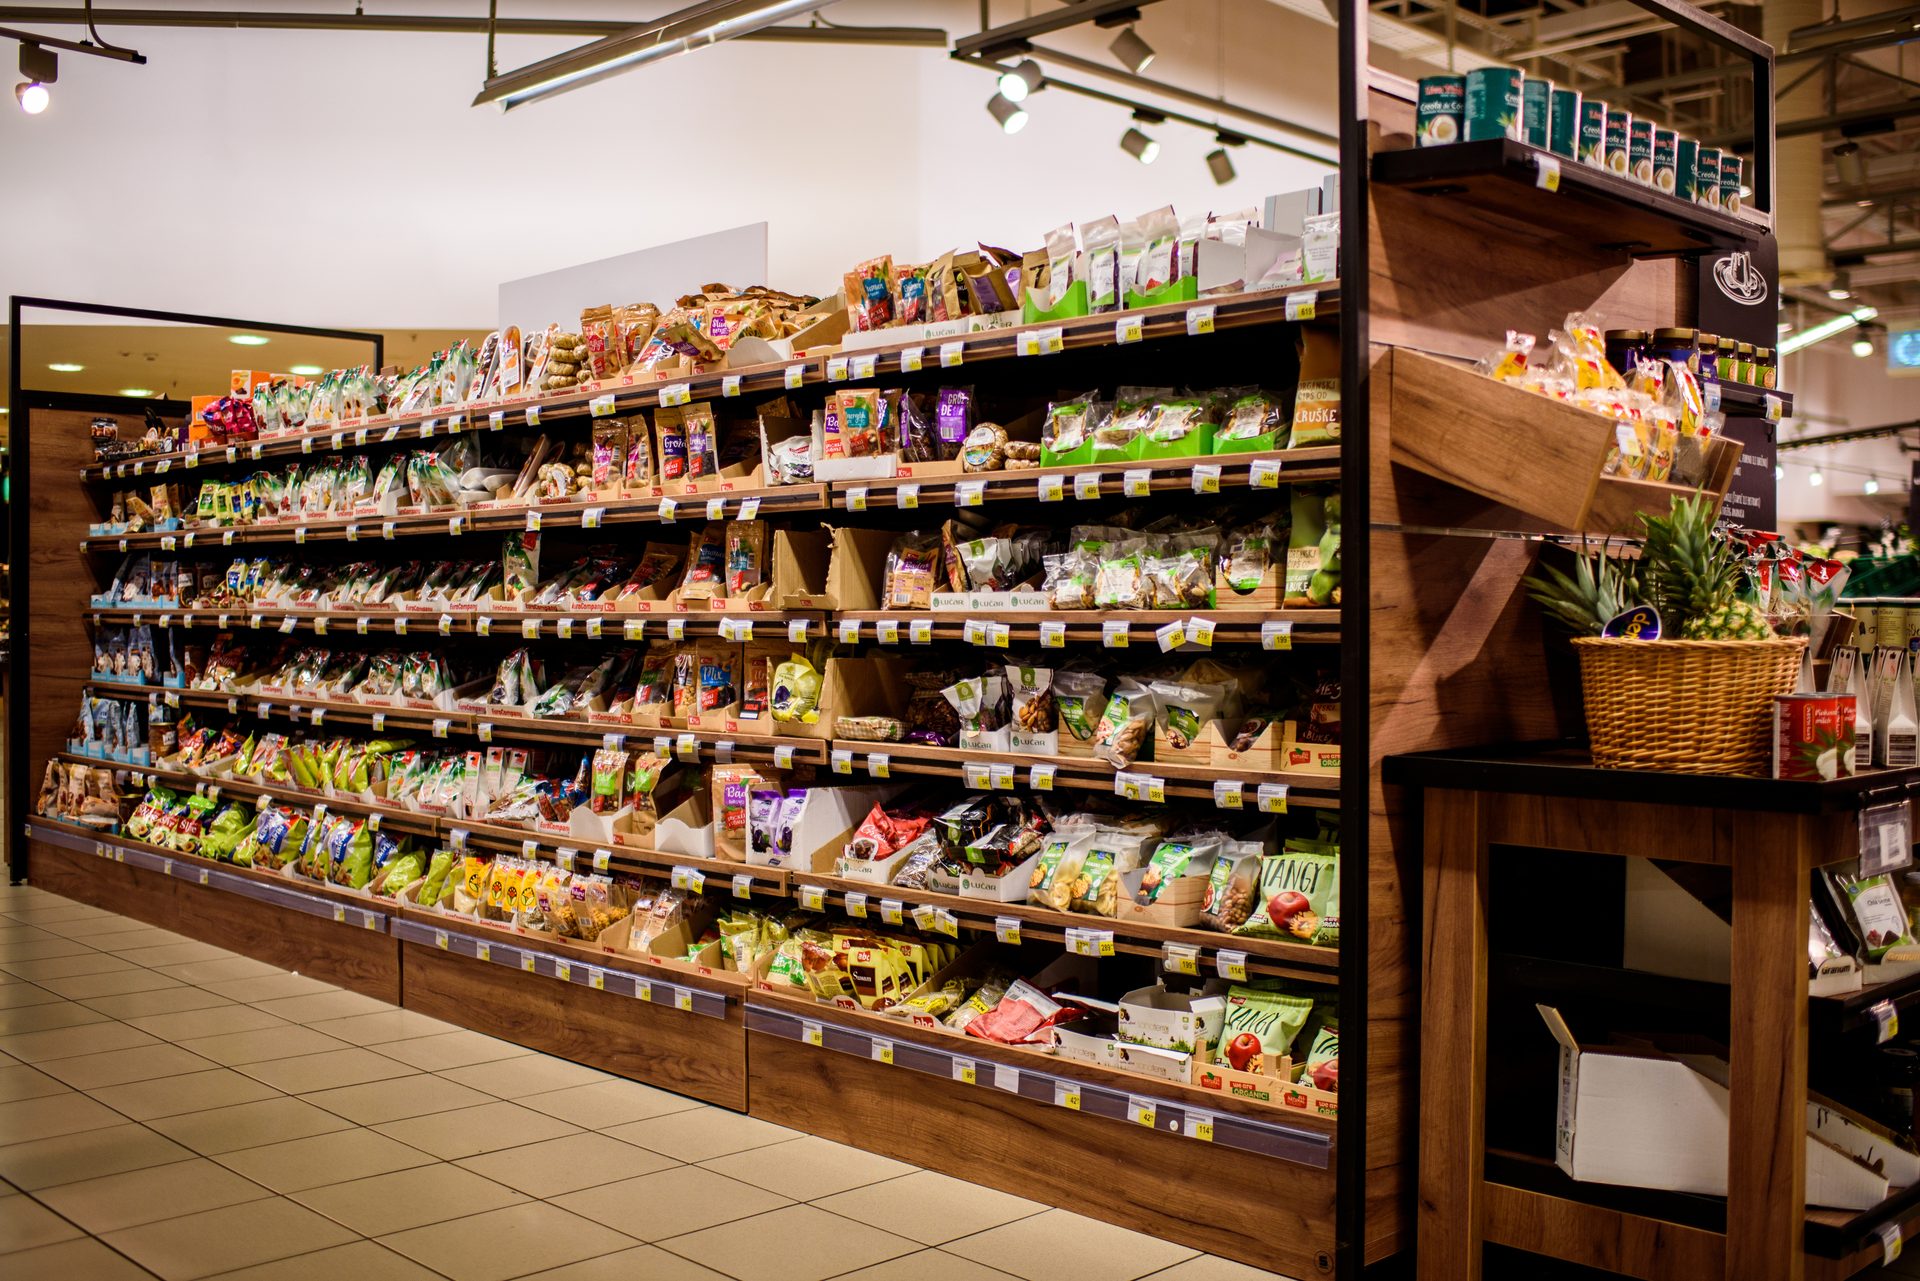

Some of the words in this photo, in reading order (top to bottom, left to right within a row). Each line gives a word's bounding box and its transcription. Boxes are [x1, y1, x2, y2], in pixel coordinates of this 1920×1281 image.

[702, 666, 723, 681] Mix
[1262, 858, 1324, 894] TANGY
[859, 952, 870, 961] abc
[1821, 965, 1851, 975] Granum
[915, 1015, 934, 1027] abc
[1228, 1005, 1283, 1037] TANGY
[1233, 1088, 1268, 1100] ORGANIC!
